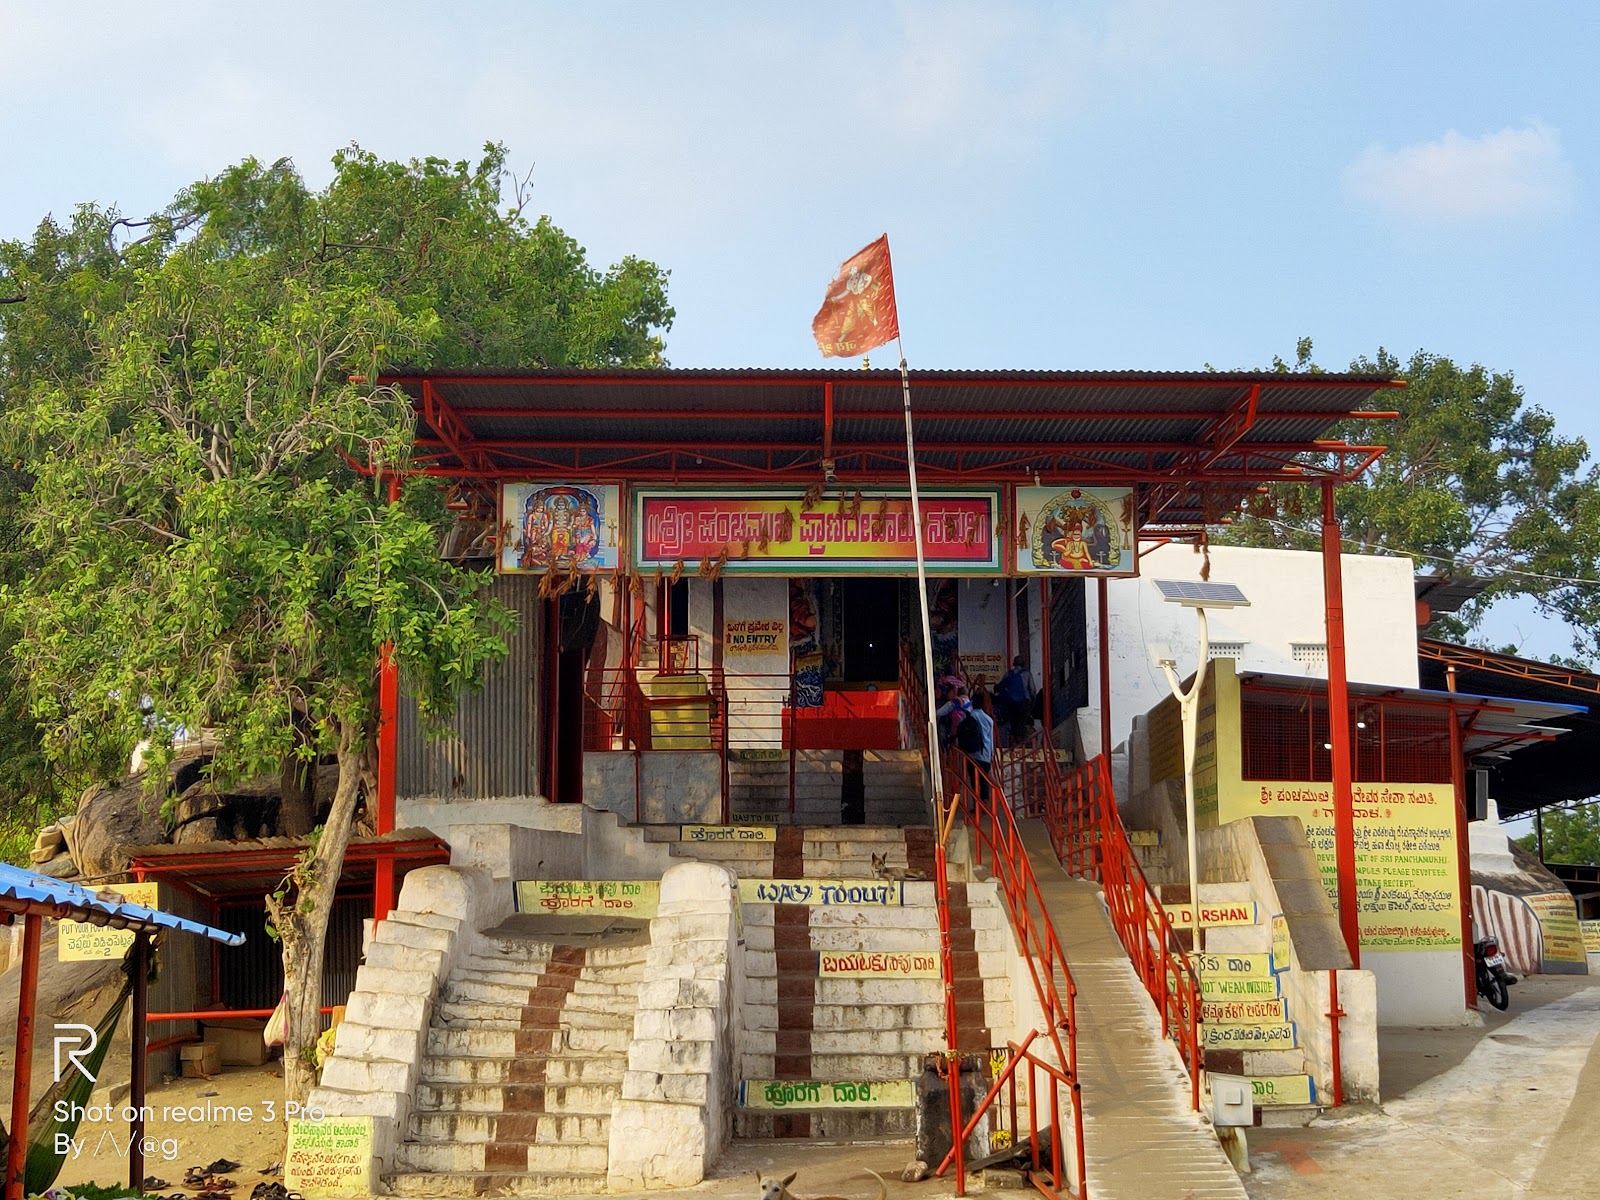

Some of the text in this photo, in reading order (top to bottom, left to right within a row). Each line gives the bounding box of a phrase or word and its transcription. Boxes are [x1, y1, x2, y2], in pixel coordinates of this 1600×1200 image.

[733, 634, 778, 644] NO ENTRY
[1260, 786, 1273, 804] ಶ್ರೀ
[1277, 788, 1330, 802] ಪಂಚಮುಖಿ
[690, 827, 736, 841] ಹೊರಗೆ
[1380, 855, 1393, 863] SRI
[1382, 868, 1410, 876] PLEASE
[757, 882, 814, 905] WAY
[539, 894, 594, 910] ಹೊರಗೆ
[1181, 907, 1249, 923] DRSHAN
[61, 923, 74, 935] PUT
[74, 923, 90, 934] YOUR
[104, 947, 111, 957] 2
[764, 1081, 822, 1106] ಹೊರಗೆ
